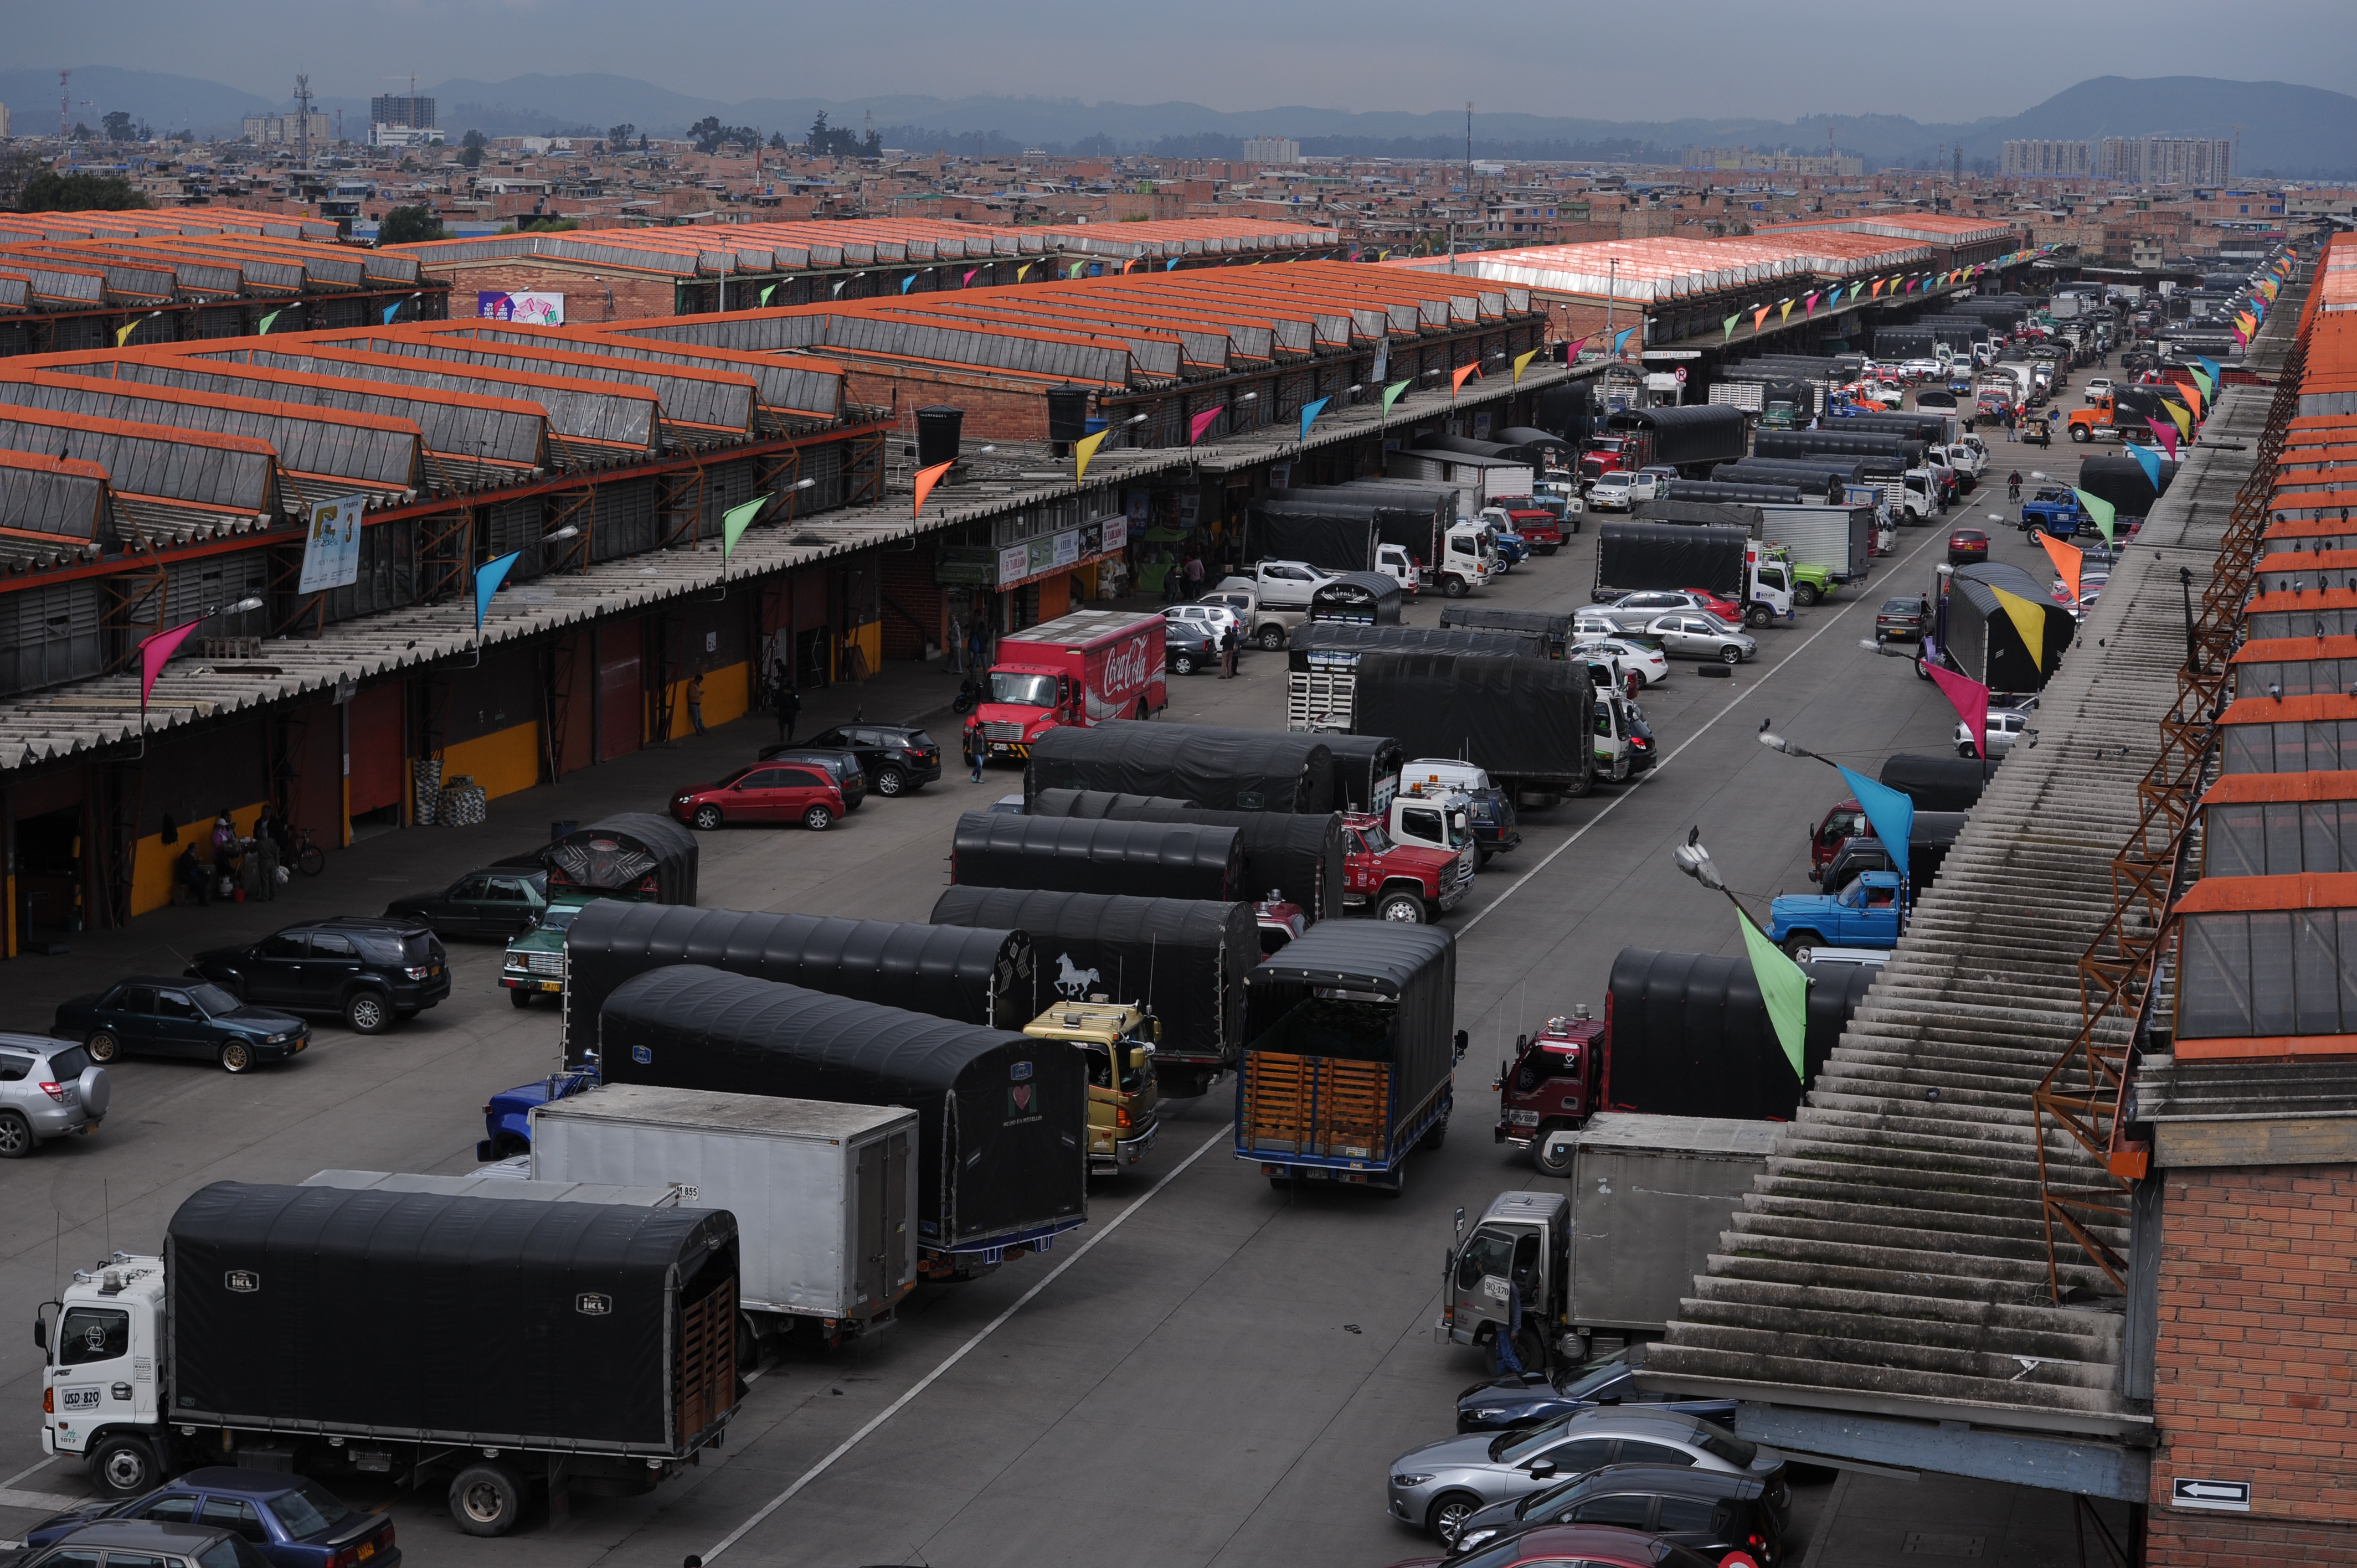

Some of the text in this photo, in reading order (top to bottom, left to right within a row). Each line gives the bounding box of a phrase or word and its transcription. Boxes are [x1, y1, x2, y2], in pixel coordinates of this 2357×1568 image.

[343, 501, 358, 509] BODEGA
[346, 513, 353, 543] 3
[1003, 1120, 1016, 1128] HECHO
[685, 1187, 697, 1196] 855
